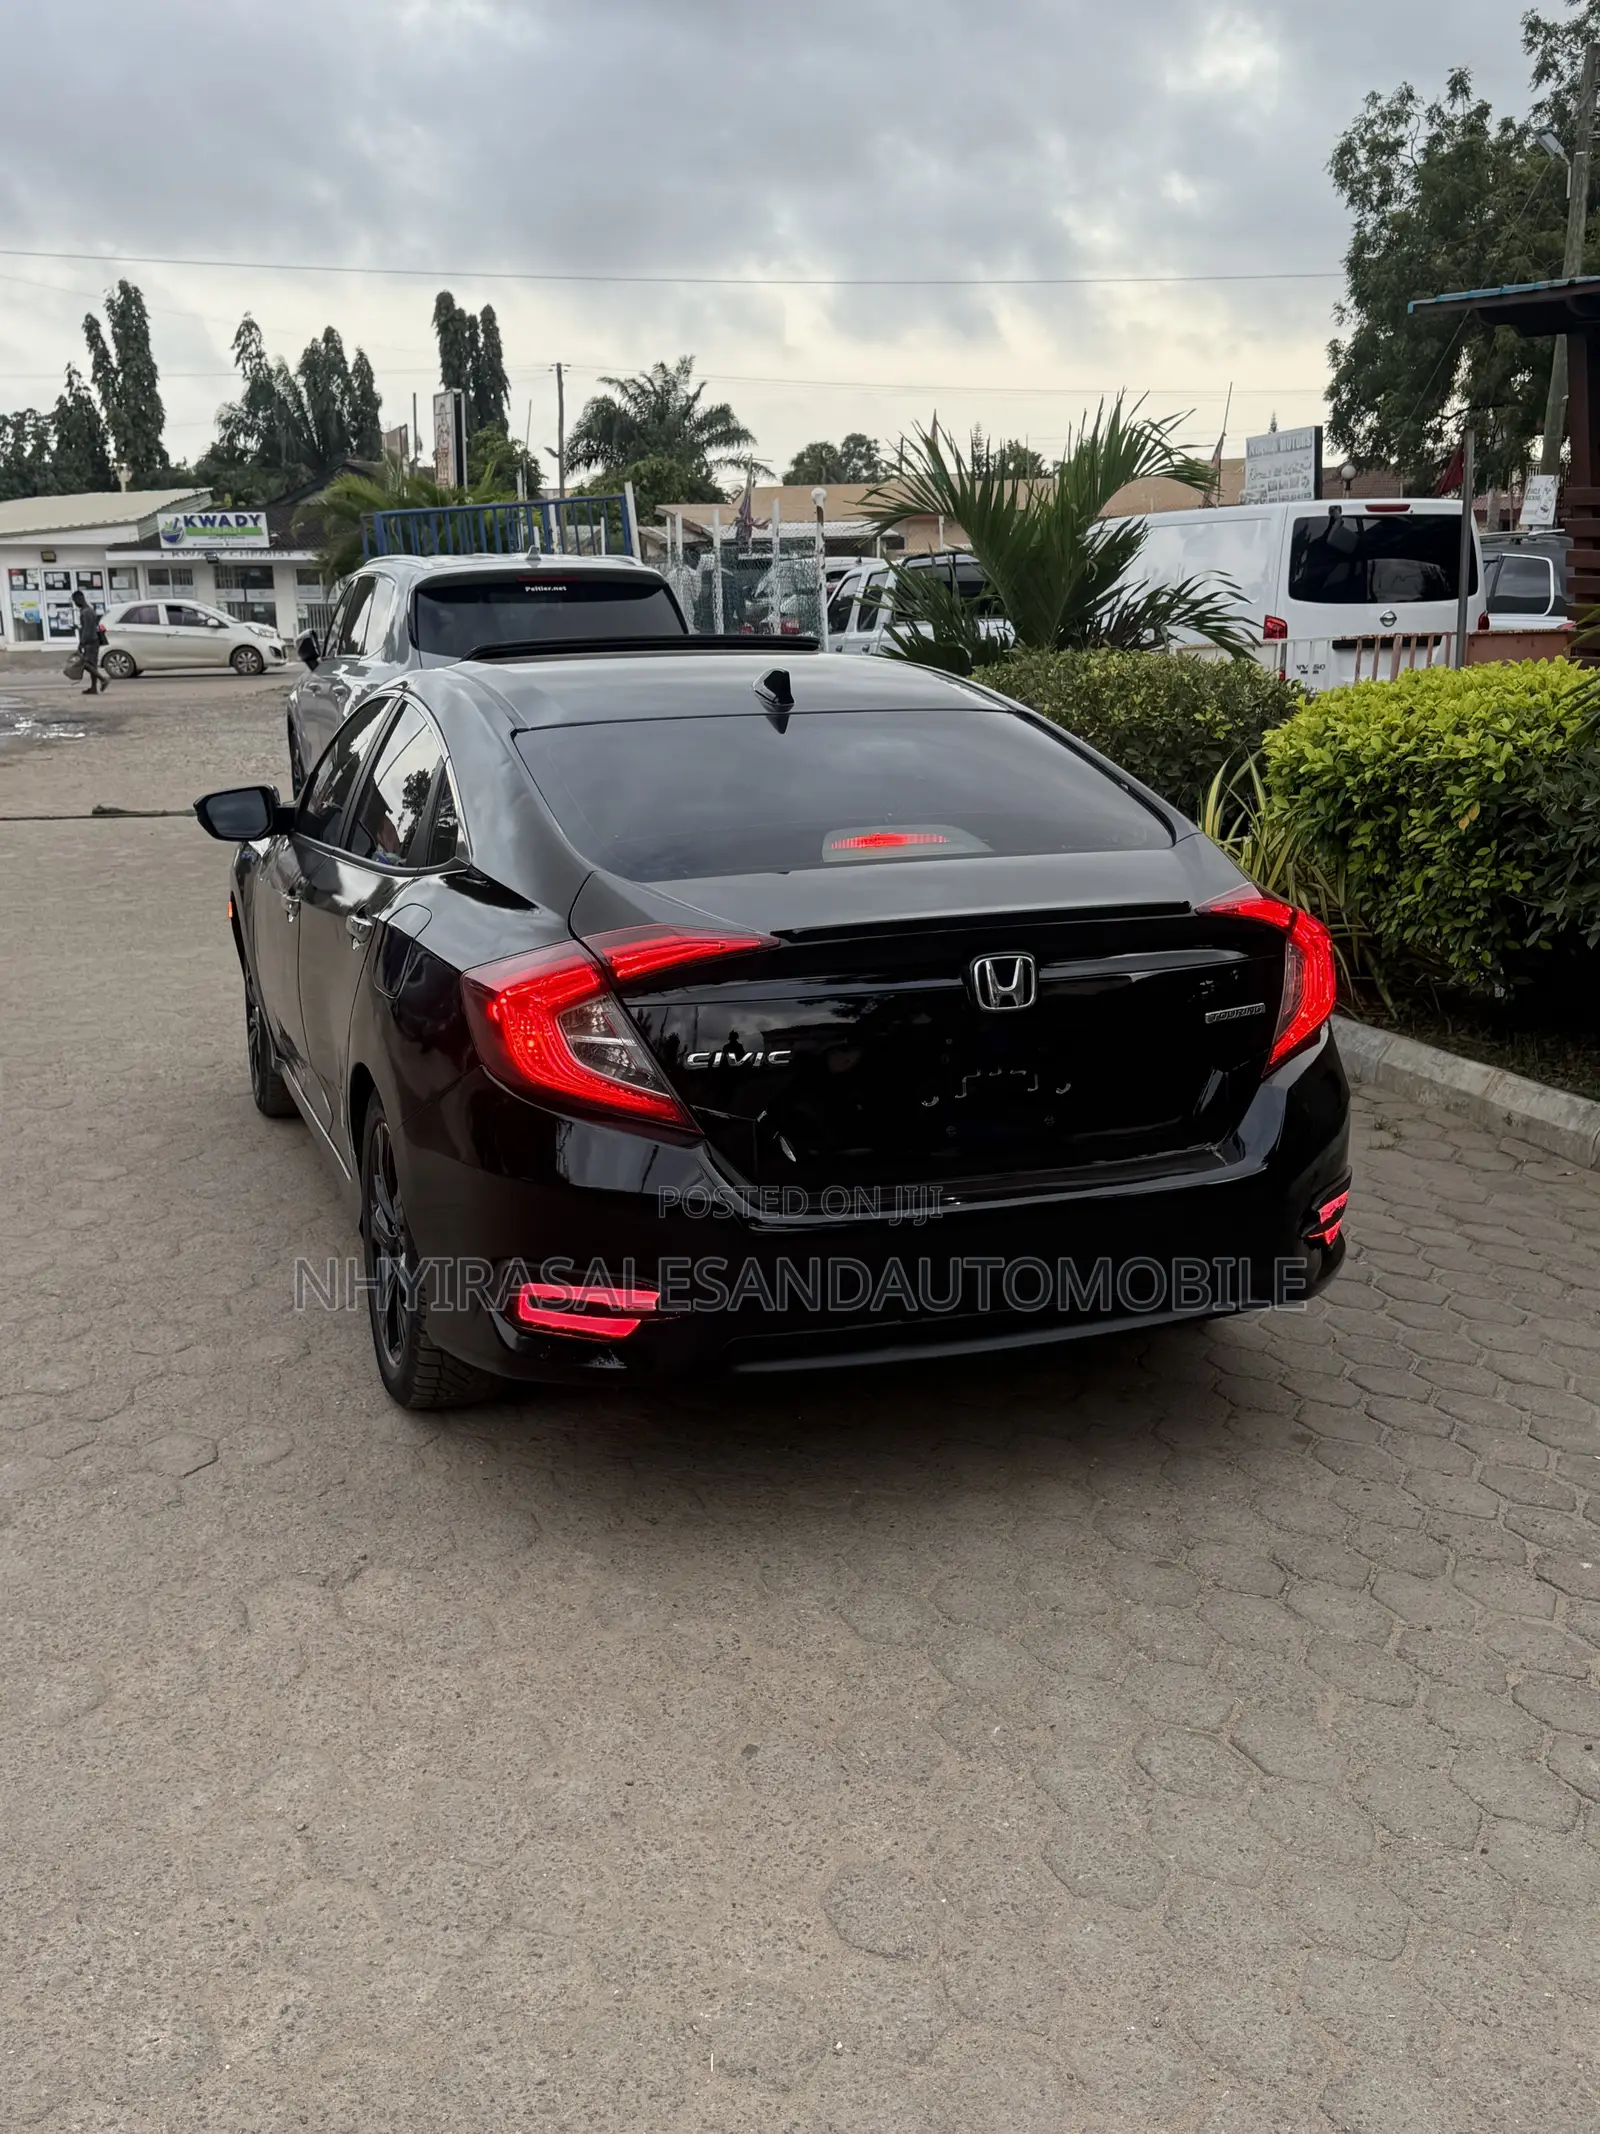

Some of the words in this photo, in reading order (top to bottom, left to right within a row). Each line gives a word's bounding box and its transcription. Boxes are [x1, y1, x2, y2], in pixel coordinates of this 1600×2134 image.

[183, 514, 261, 528] KWADY
[1208, 1003, 1264, 1022] TOURING
[686, 1050, 792, 1069] CIVIC
